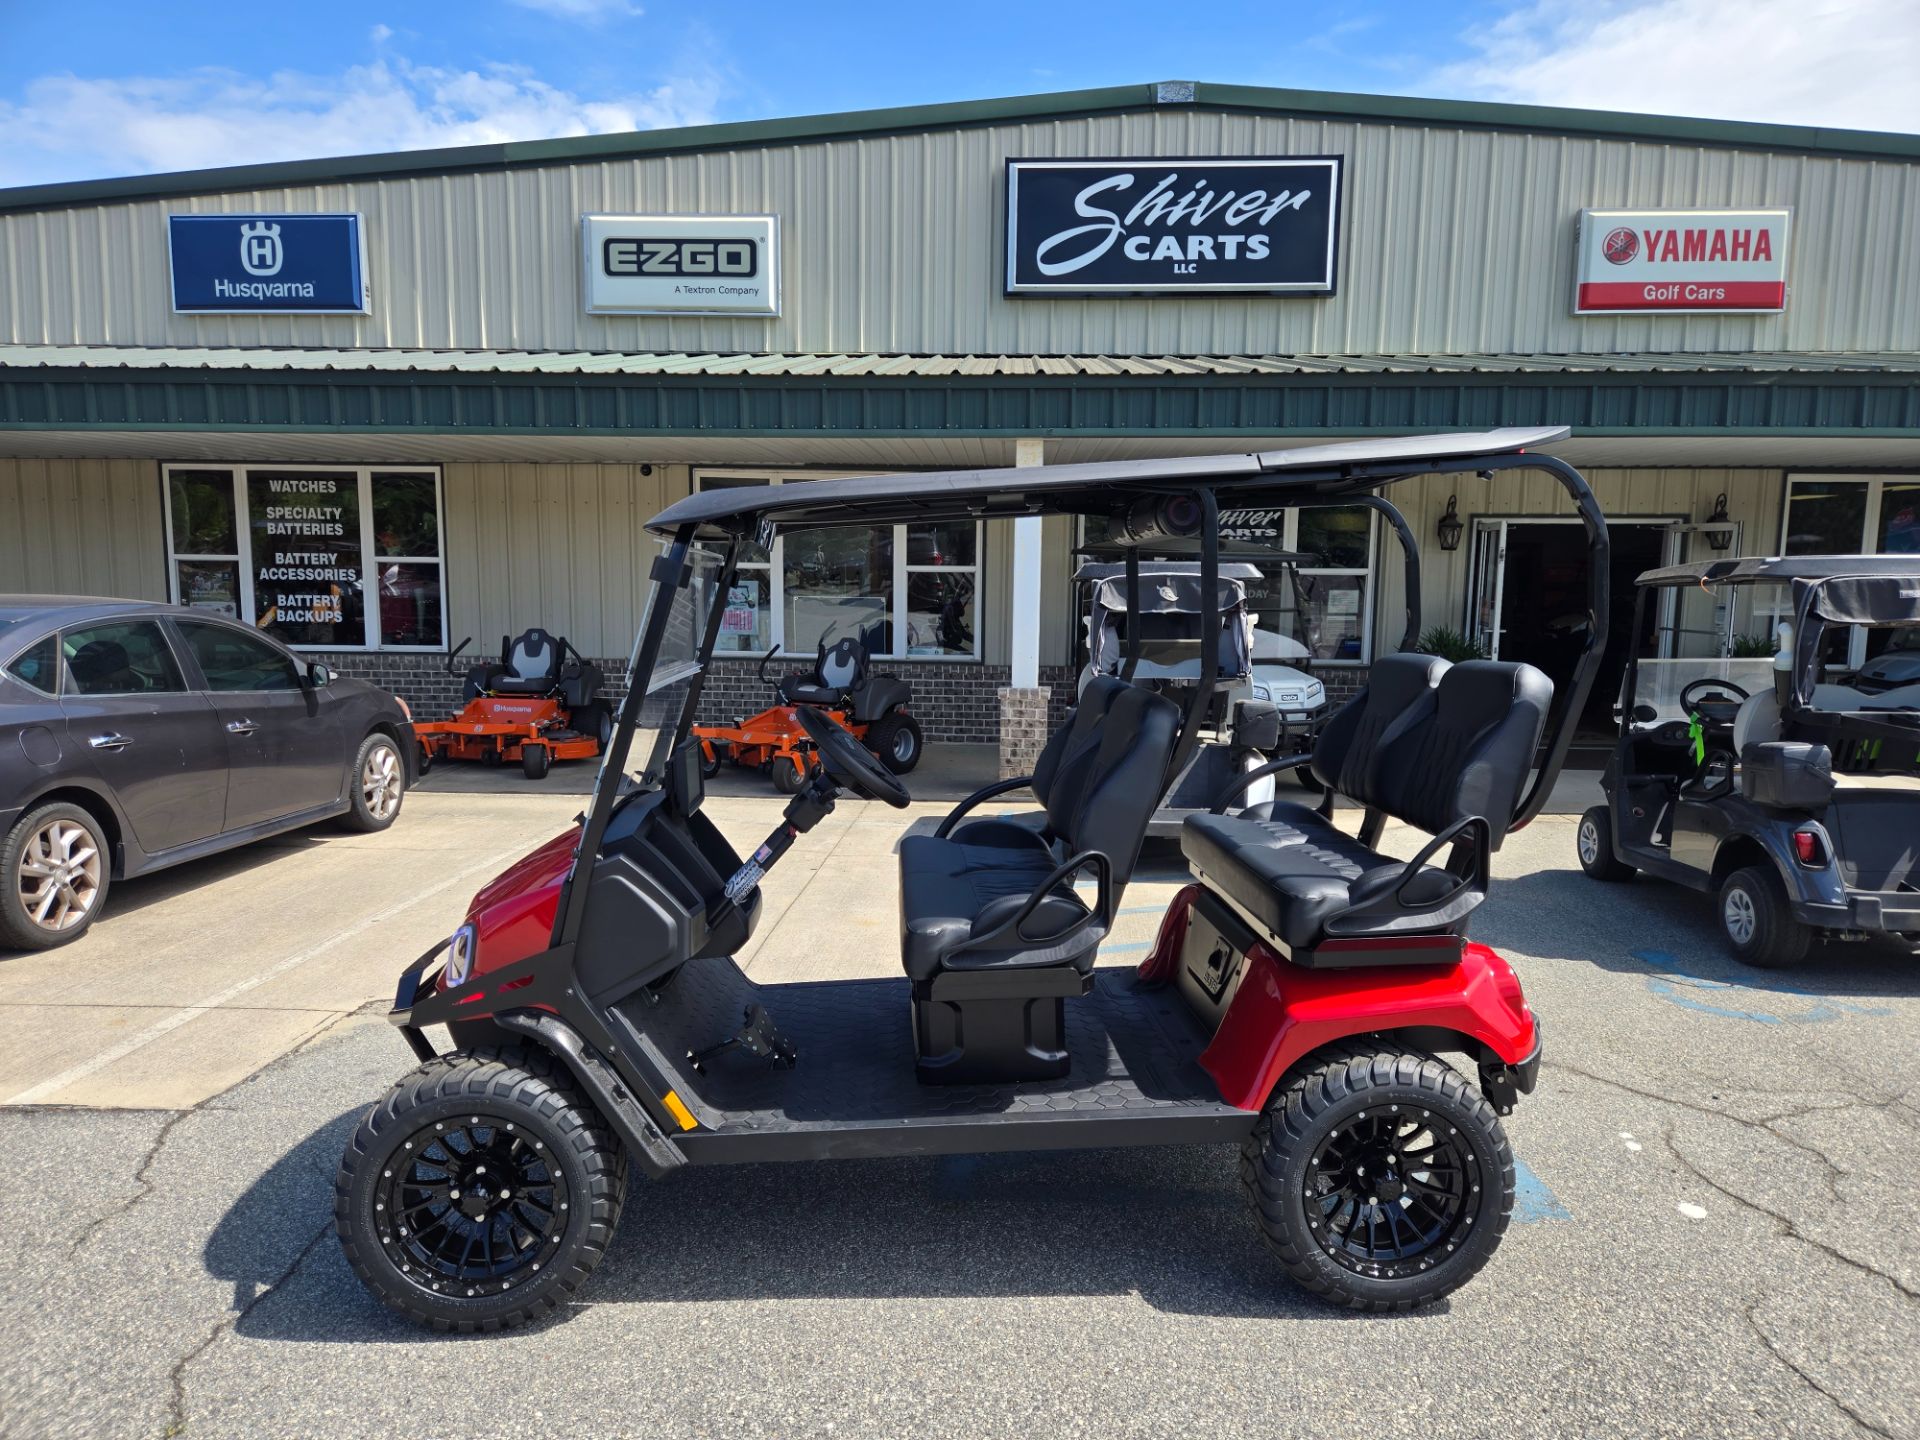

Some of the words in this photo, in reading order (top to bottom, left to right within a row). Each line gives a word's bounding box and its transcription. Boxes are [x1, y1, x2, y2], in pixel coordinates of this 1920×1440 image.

[1036, 173, 1312, 276] Shiver
[1123, 234, 1271, 261] CARTS
[1643, 229, 1773, 262] YAMAHA
[609, 243, 751, 274] EZGO
[1173, 263, 1197, 274] LLC
[214, 279, 315, 300] Husqvarna
[674, 285, 681, 294] A
[684, 286, 716, 294] Textron
[718, 286, 760, 297] Company
[1643, 285, 1680, 300] Golf
[1684, 285, 1726, 300] Cars
[269, 480, 337, 494] WATCHES
[266, 506, 343, 520] SPECIALTY
[266, 523, 344, 536] BATTERIES
[1218, 528, 1278, 537] ARTS
[275, 552, 338, 565] BATTERY
[259, 567, 357, 581] ACCESSORIES
[277, 595, 340, 608] BATTERY
[276, 610, 343, 624] BACKUPS
